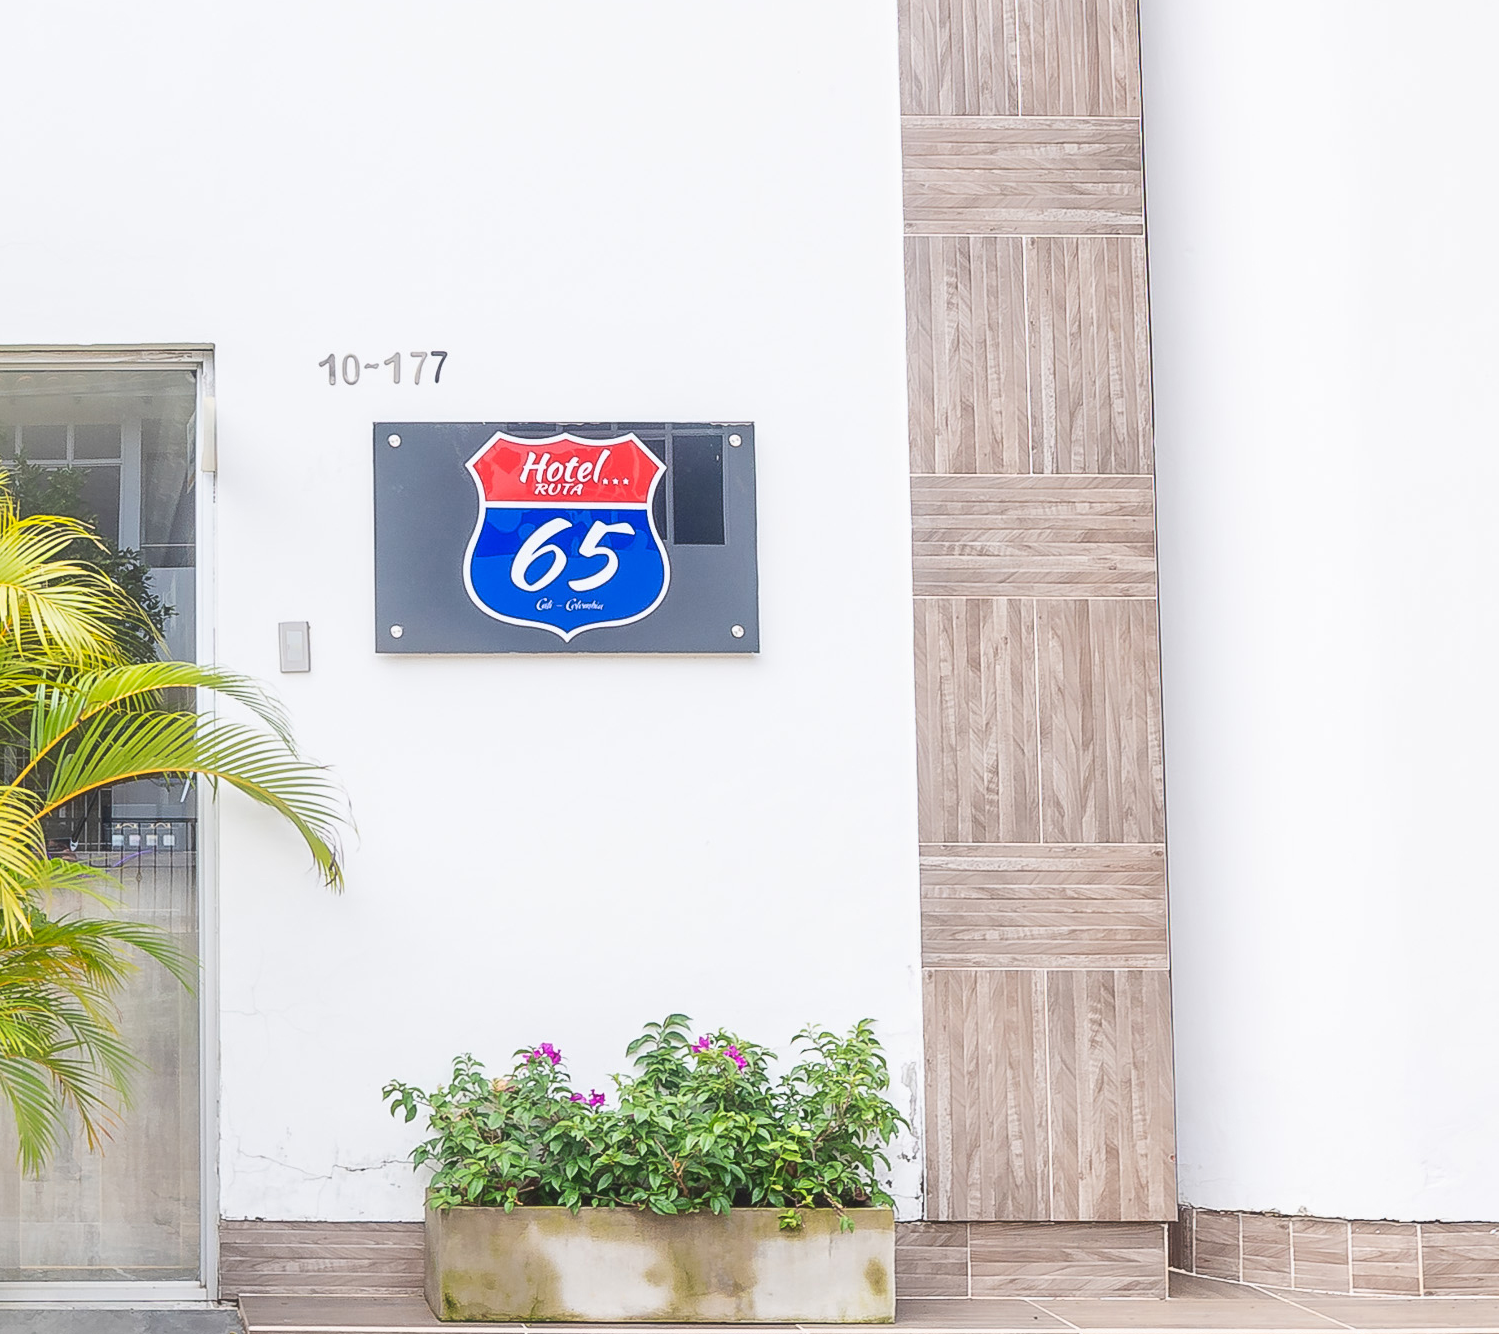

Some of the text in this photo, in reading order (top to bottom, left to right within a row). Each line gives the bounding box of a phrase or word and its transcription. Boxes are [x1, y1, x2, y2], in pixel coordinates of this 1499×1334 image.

[318, 349, 449, 386] 10-177
[534, 482, 584, 496] RUTA
[510, 517, 636, 593] 65
